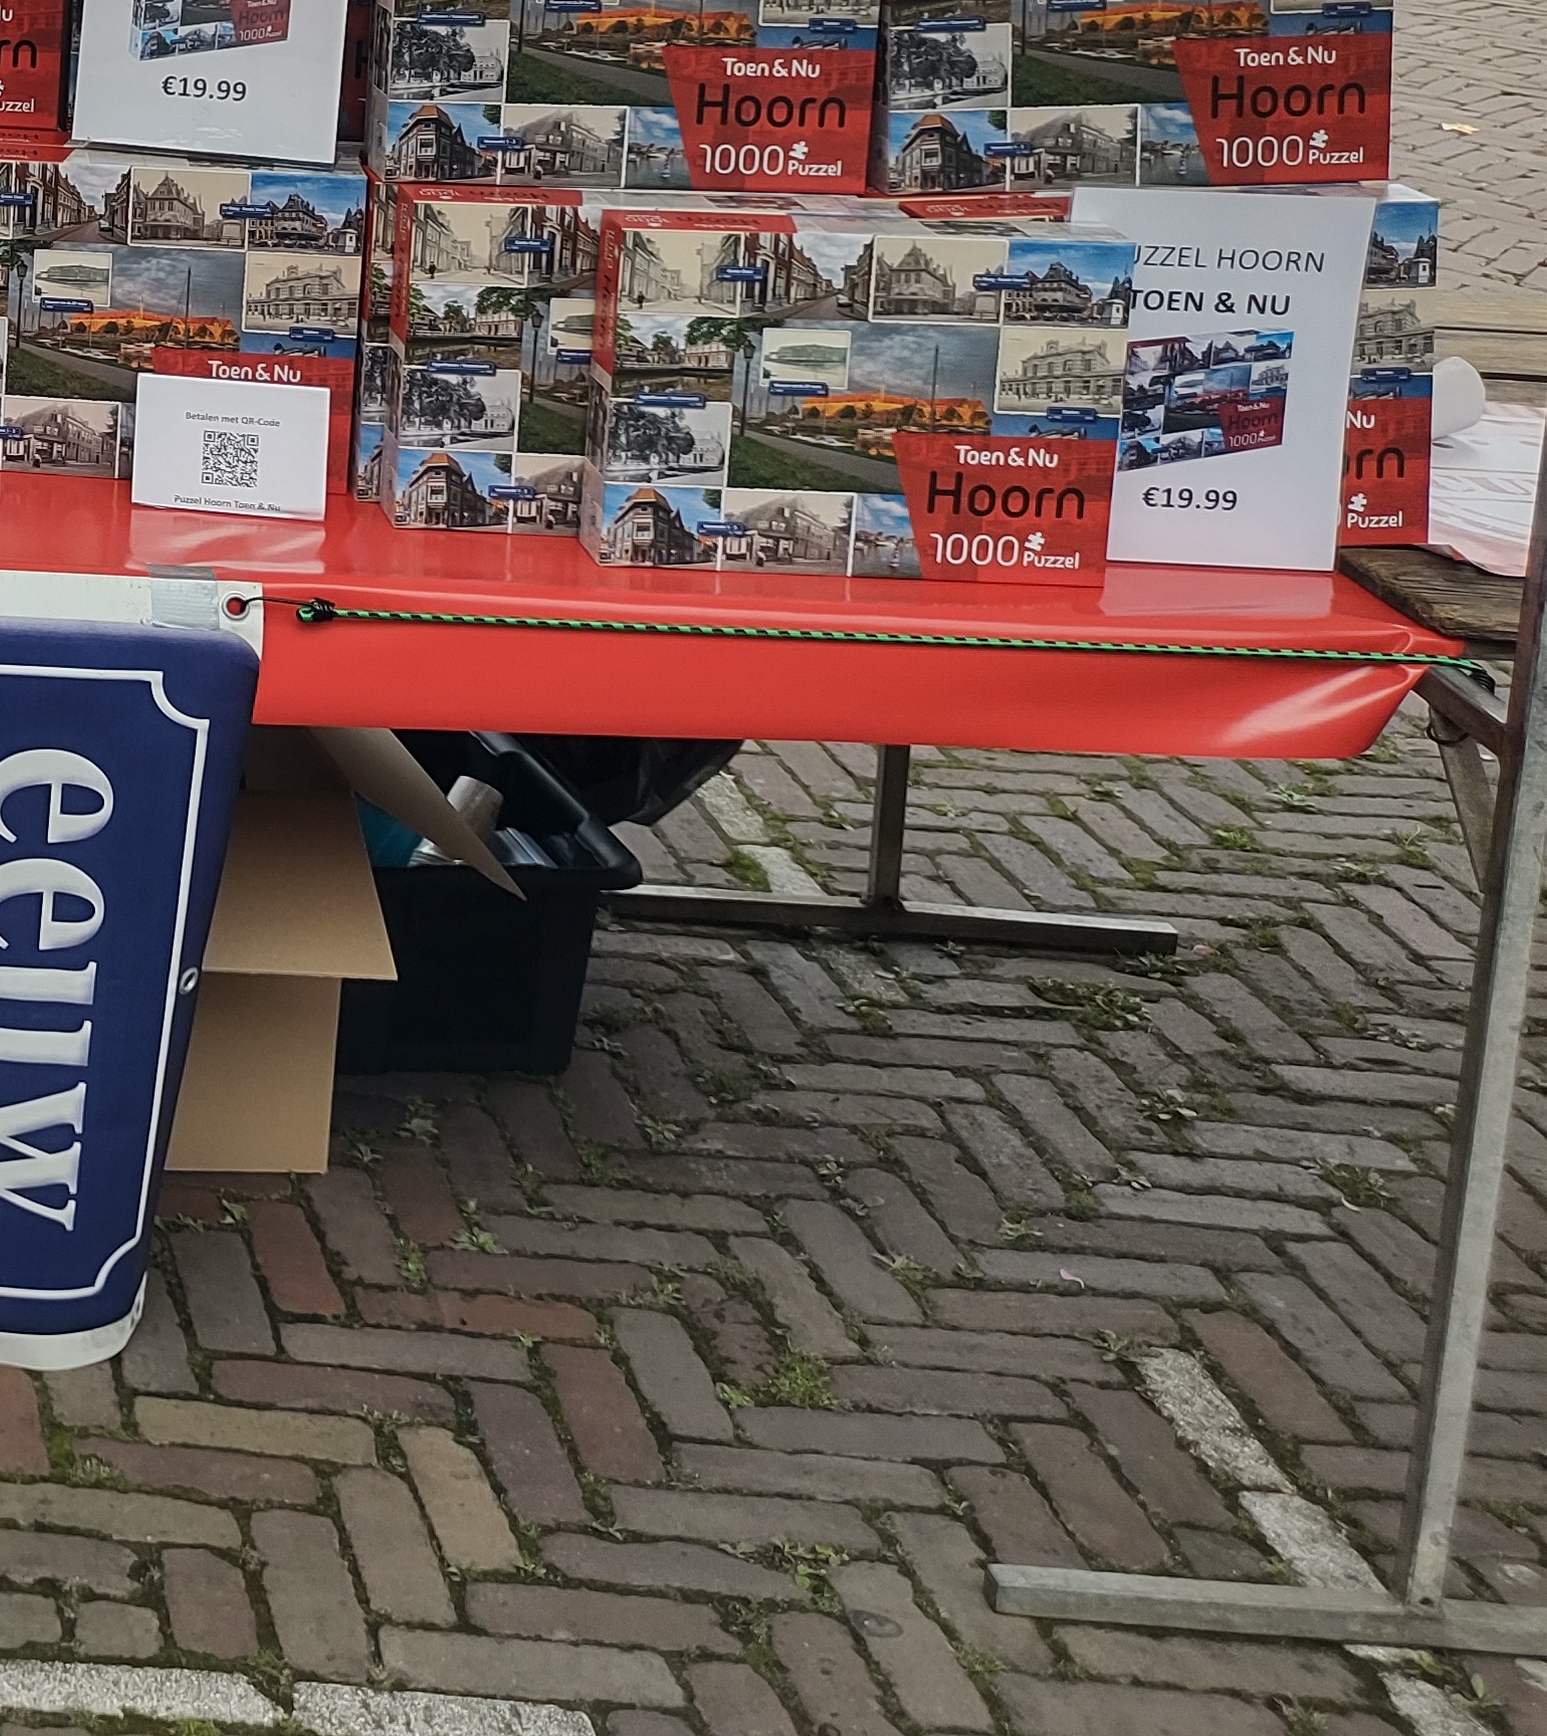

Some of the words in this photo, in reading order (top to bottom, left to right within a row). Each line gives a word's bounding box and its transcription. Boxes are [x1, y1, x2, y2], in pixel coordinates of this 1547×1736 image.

[721, 58, 771, 78] Toen
[773, 59, 789, 78] &
[790, 59, 820, 79] Nu
[1234, 47, 1284, 67] Toen
[1287, 47, 1304, 67] &
[1306, 45, 1337, 65] Nu
[161, 75, 247, 101] €19.99
[1210, 74, 1367, 120] Hoorn
[696, 83, 847, 129] Hoorn
[699, 143, 785, 176] 1000
[787, 159, 842, 178] Puzzel
[1215, 133, 1304, 168] 1000
[1308, 146, 1364, 167] Puzzel
[1133, 245, 1207, 269] UZZEL
[1217, 248, 1326, 274] HOORN
[1130, 288, 1204, 313] TOEN
[1214, 291, 1236, 314] &
[1247, 293, 1291, 316] NU
[207, 361, 252, 381] Toen
[256, 363, 271, 381] &
[274, 364, 301, 383] Nu
[185, 411, 220, 423] Betalen
[222, 415, 240, 424] met
[242, 415, 282, 428] QR-Code
[954, 445, 1005, 466] Toen
[1007, 447, 1025, 467] &
[1026, 449, 1059, 468] Nu
[927, 470, 1085, 520] Hoorn
[1142, 486, 1238, 512] €19.99
[1347, 511, 1403, 529] Puzzel
[930, 531, 1020, 568] 1000
[1022, 549, 1079, 570] Puzzel
